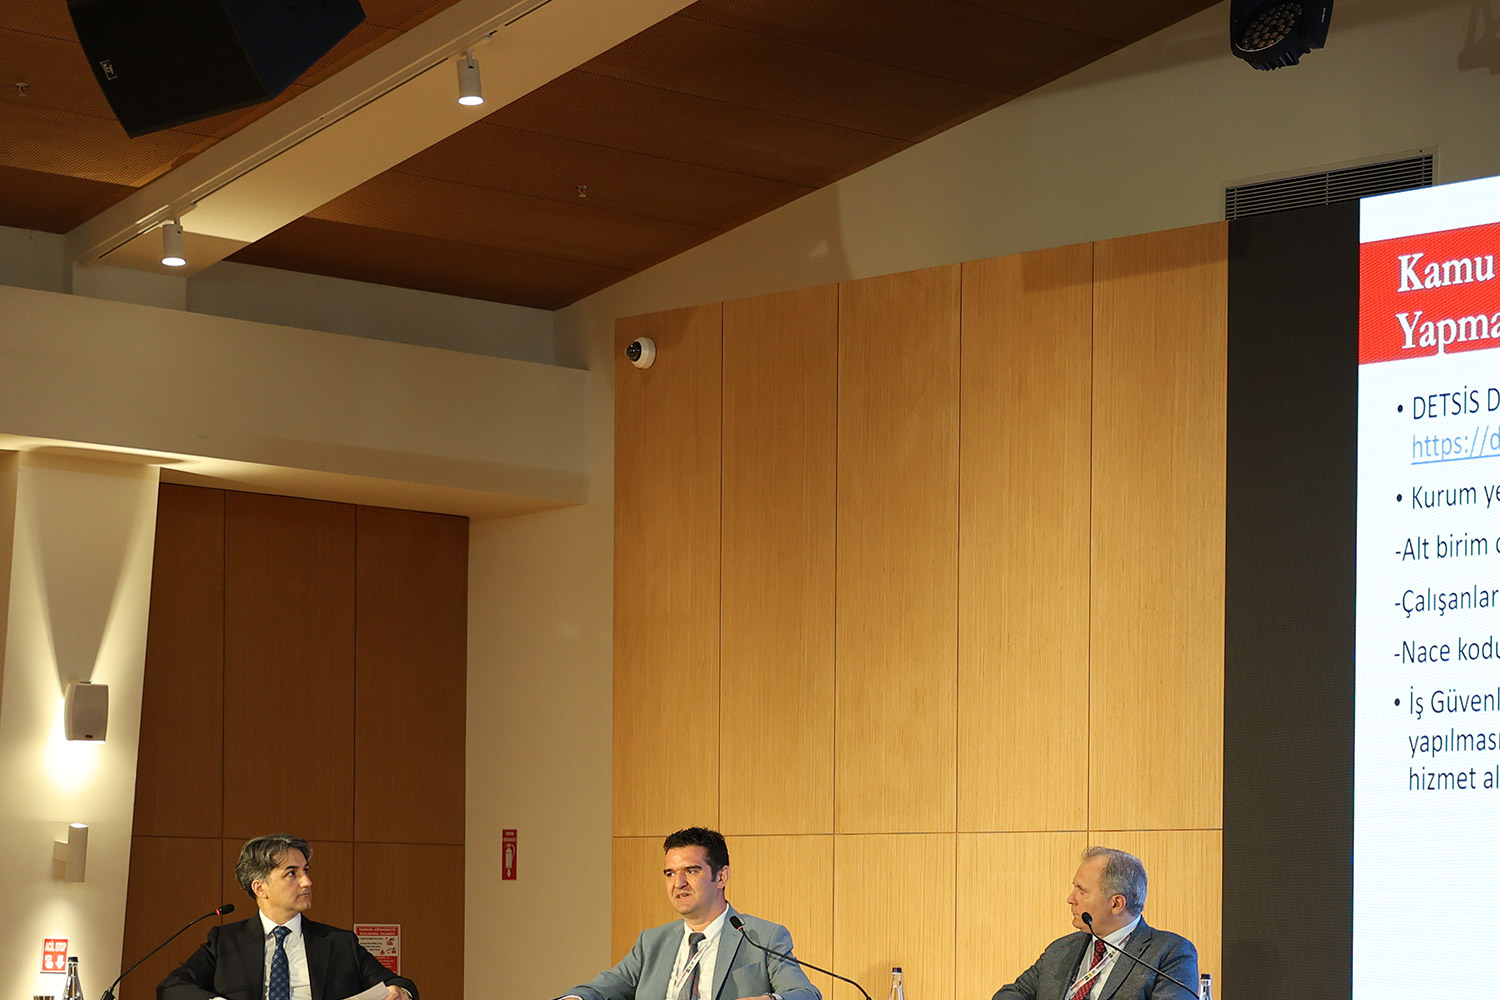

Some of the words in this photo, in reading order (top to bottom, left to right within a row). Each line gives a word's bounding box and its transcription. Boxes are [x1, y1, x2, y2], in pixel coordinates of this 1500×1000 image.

[1398, 253, 1495, 292] Kamu
[1414, 385, 1479, 420] DETSİS
[1413, 486, 1476, 509] Kurum
[1396, 537, 1429, 561] -Alt
[1437, 533, 1487, 558] birim
[1395, 641, 1450, 664] -Nace
[1411, 686, 1423, 720] İş
[1410, 767, 1476, 790] hizmet
